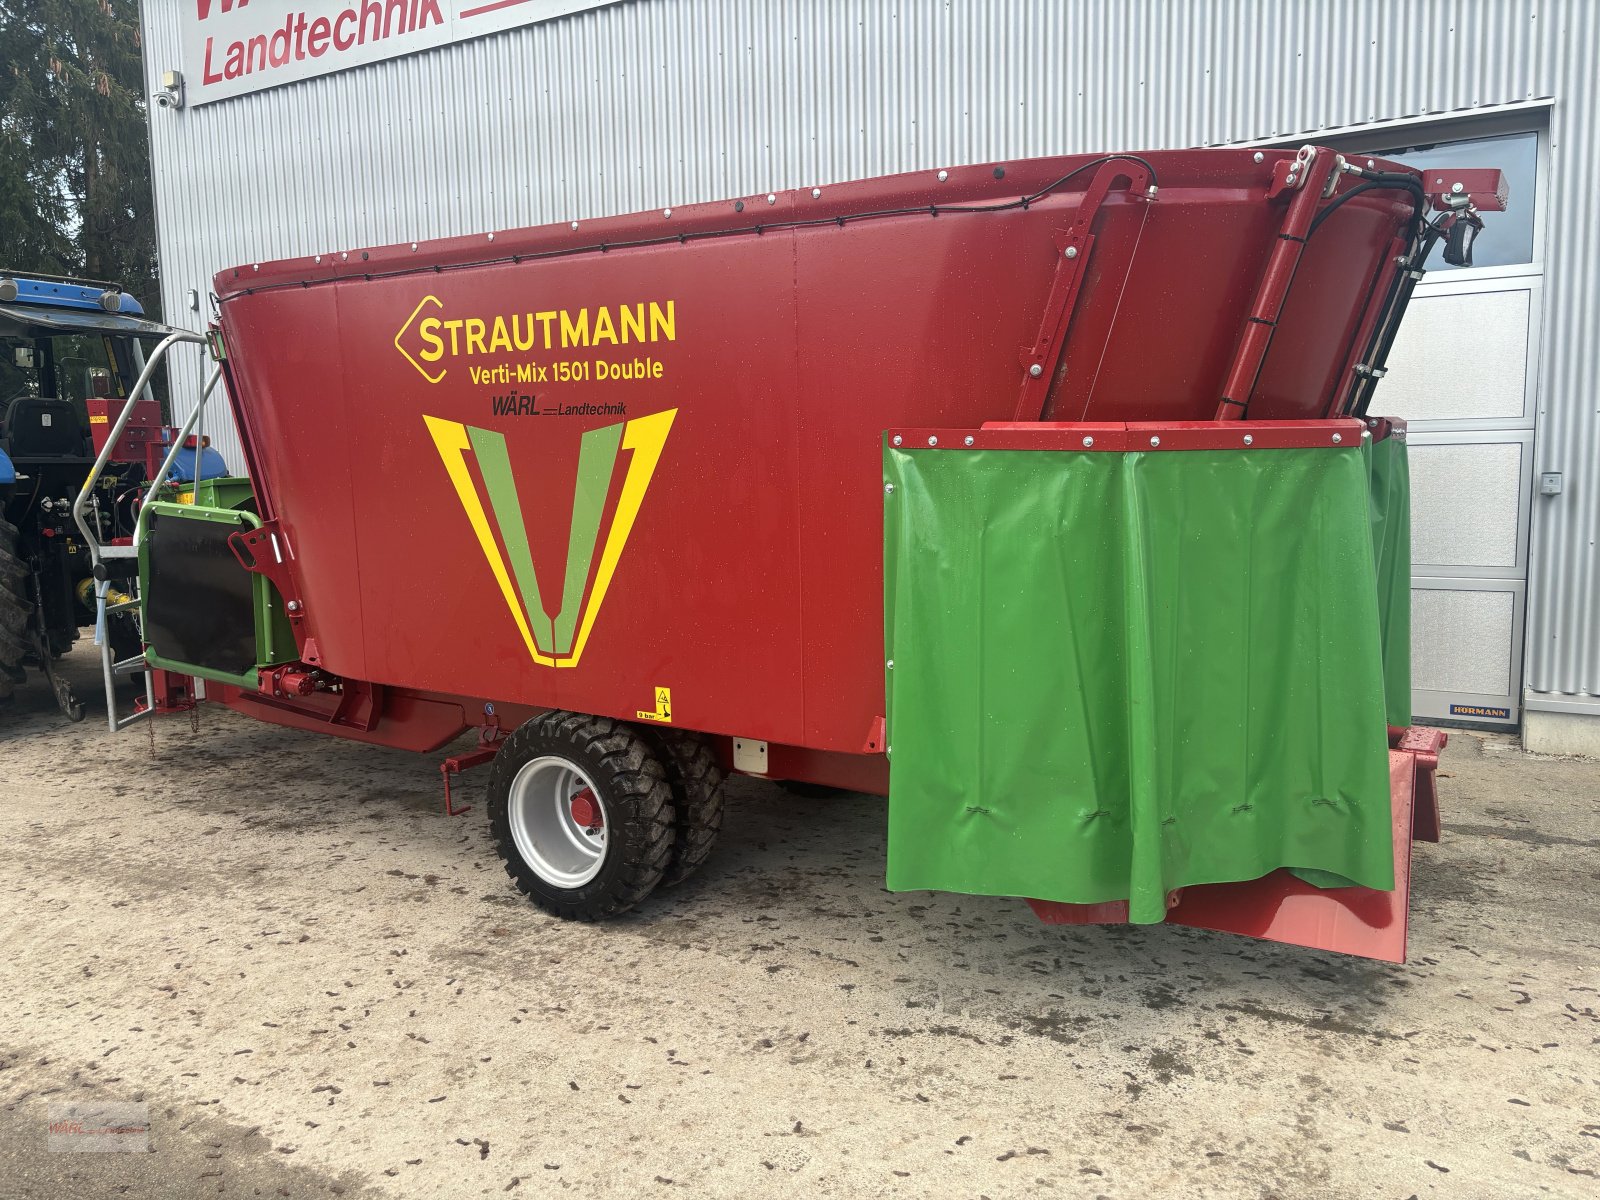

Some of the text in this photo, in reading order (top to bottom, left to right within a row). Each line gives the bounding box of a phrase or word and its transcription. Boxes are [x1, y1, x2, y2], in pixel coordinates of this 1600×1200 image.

[419, 300, 676, 362] STRAUTMANN
[469, 357, 664, 385] Verti-Mix 1501 Double
[491, 391, 627, 416] WÄRL Landtechnik
